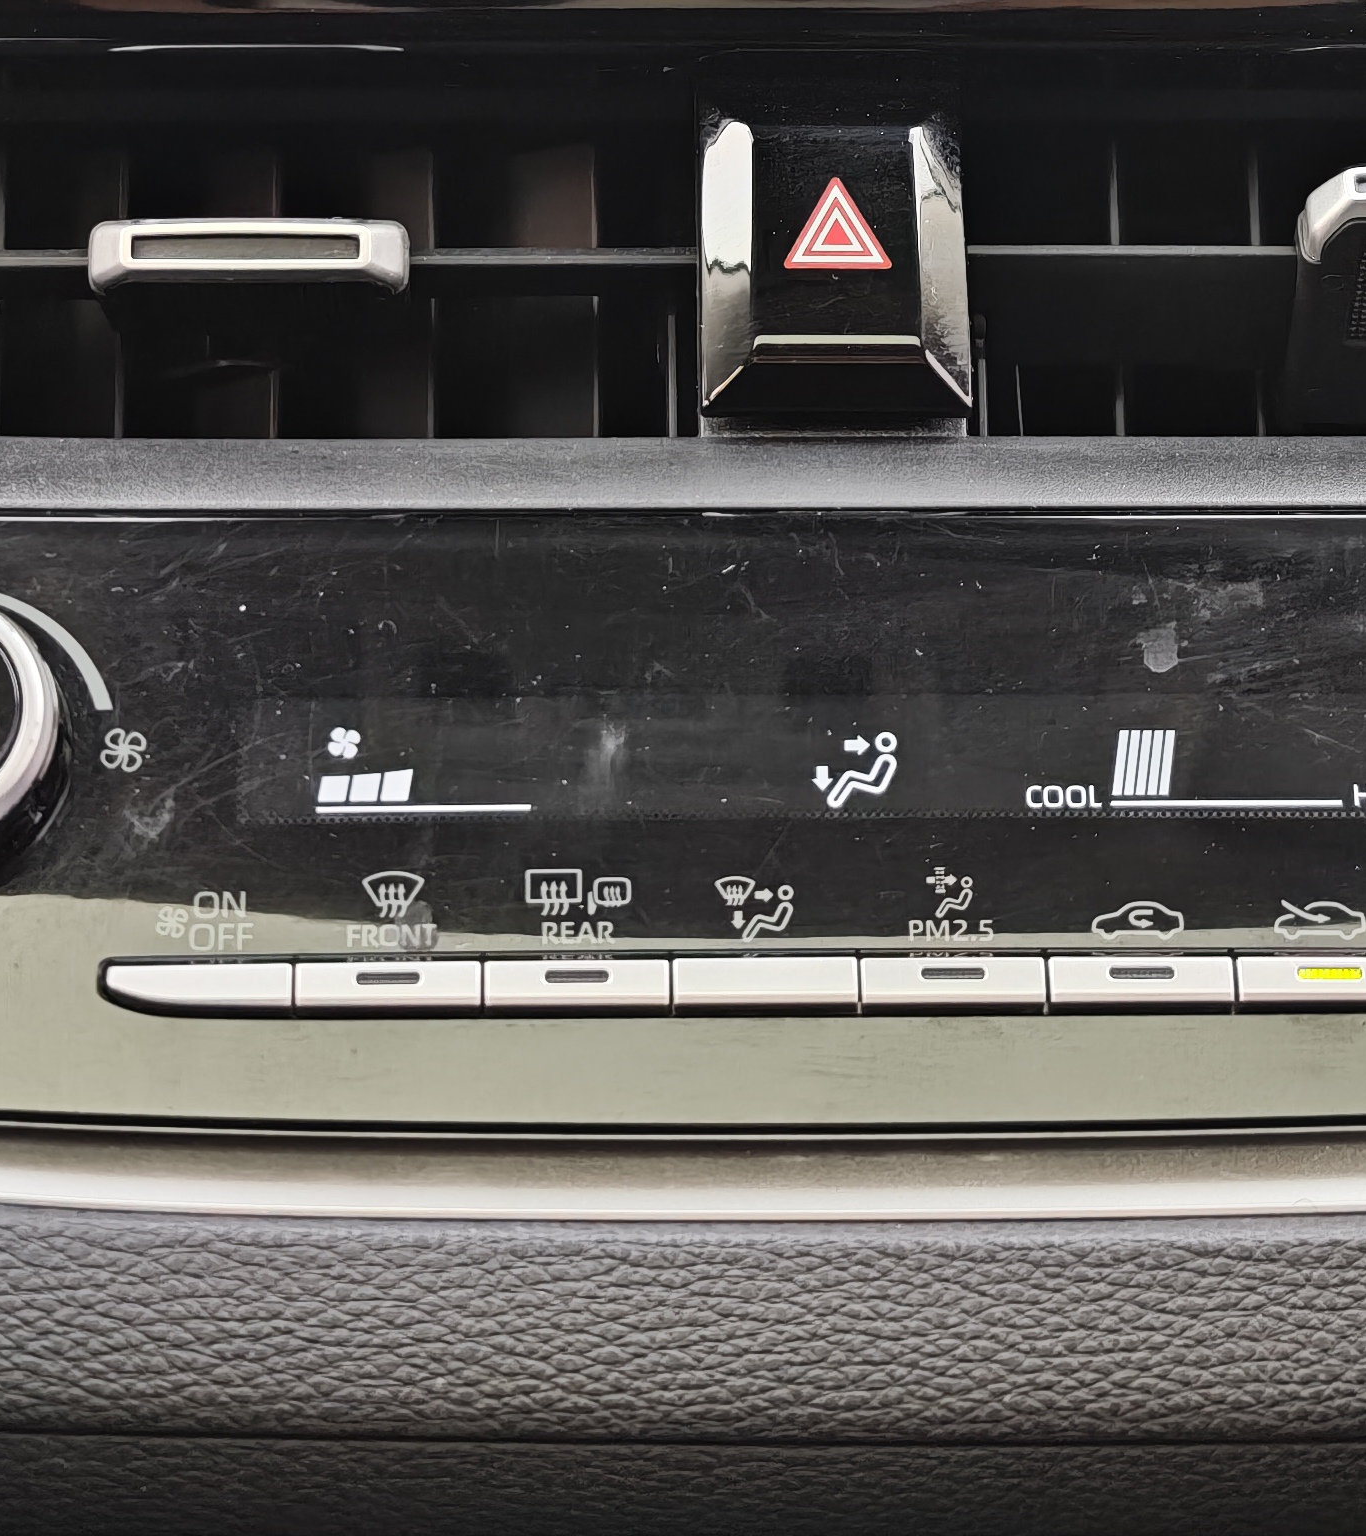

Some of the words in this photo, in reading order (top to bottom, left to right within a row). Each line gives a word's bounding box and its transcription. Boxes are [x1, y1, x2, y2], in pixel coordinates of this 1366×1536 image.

[1025, 785, 1102, 809] COOL
[192, 892, 247, 919] ON
[188, 923, 253, 951] OFF
[346, 923, 437, 947] FRONT
[541, 921, 615, 944] REAR
[909, 920, 994, 942] PM2.5
